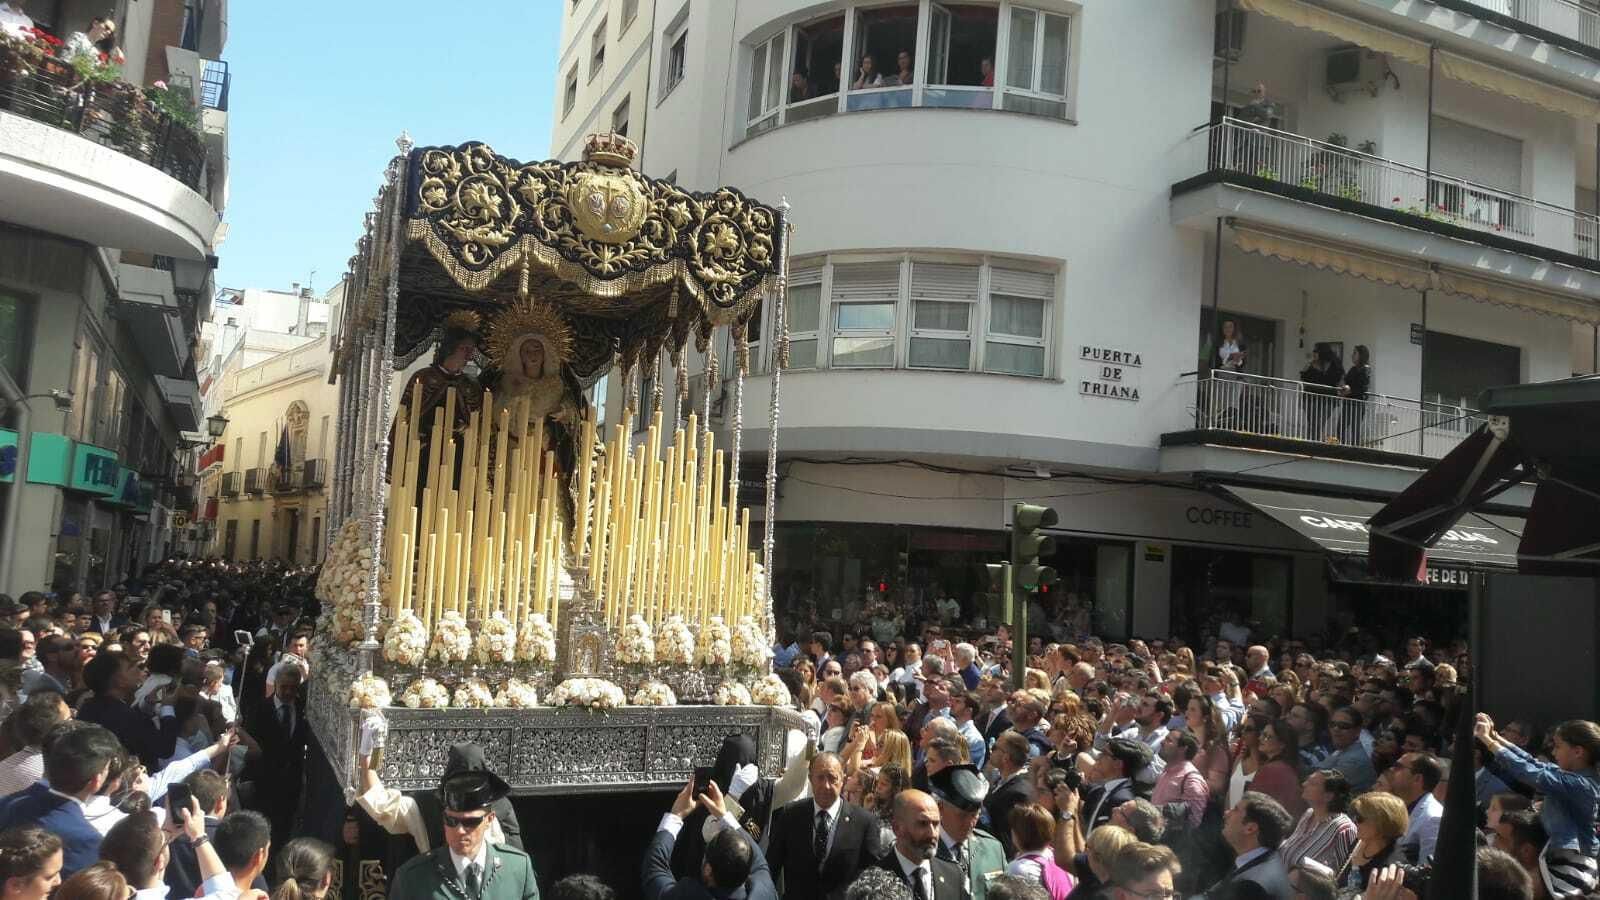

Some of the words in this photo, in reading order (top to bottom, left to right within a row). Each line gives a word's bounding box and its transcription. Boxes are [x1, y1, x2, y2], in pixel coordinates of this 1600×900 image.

[1082, 346, 1142, 365] PUERTA
[1103, 367, 1122, 380] DE
[1082, 381, 1140, 399] TRIANA
[1186, 506, 1253, 528] COFFEE
[1441, 569, 1457, 584] DE
